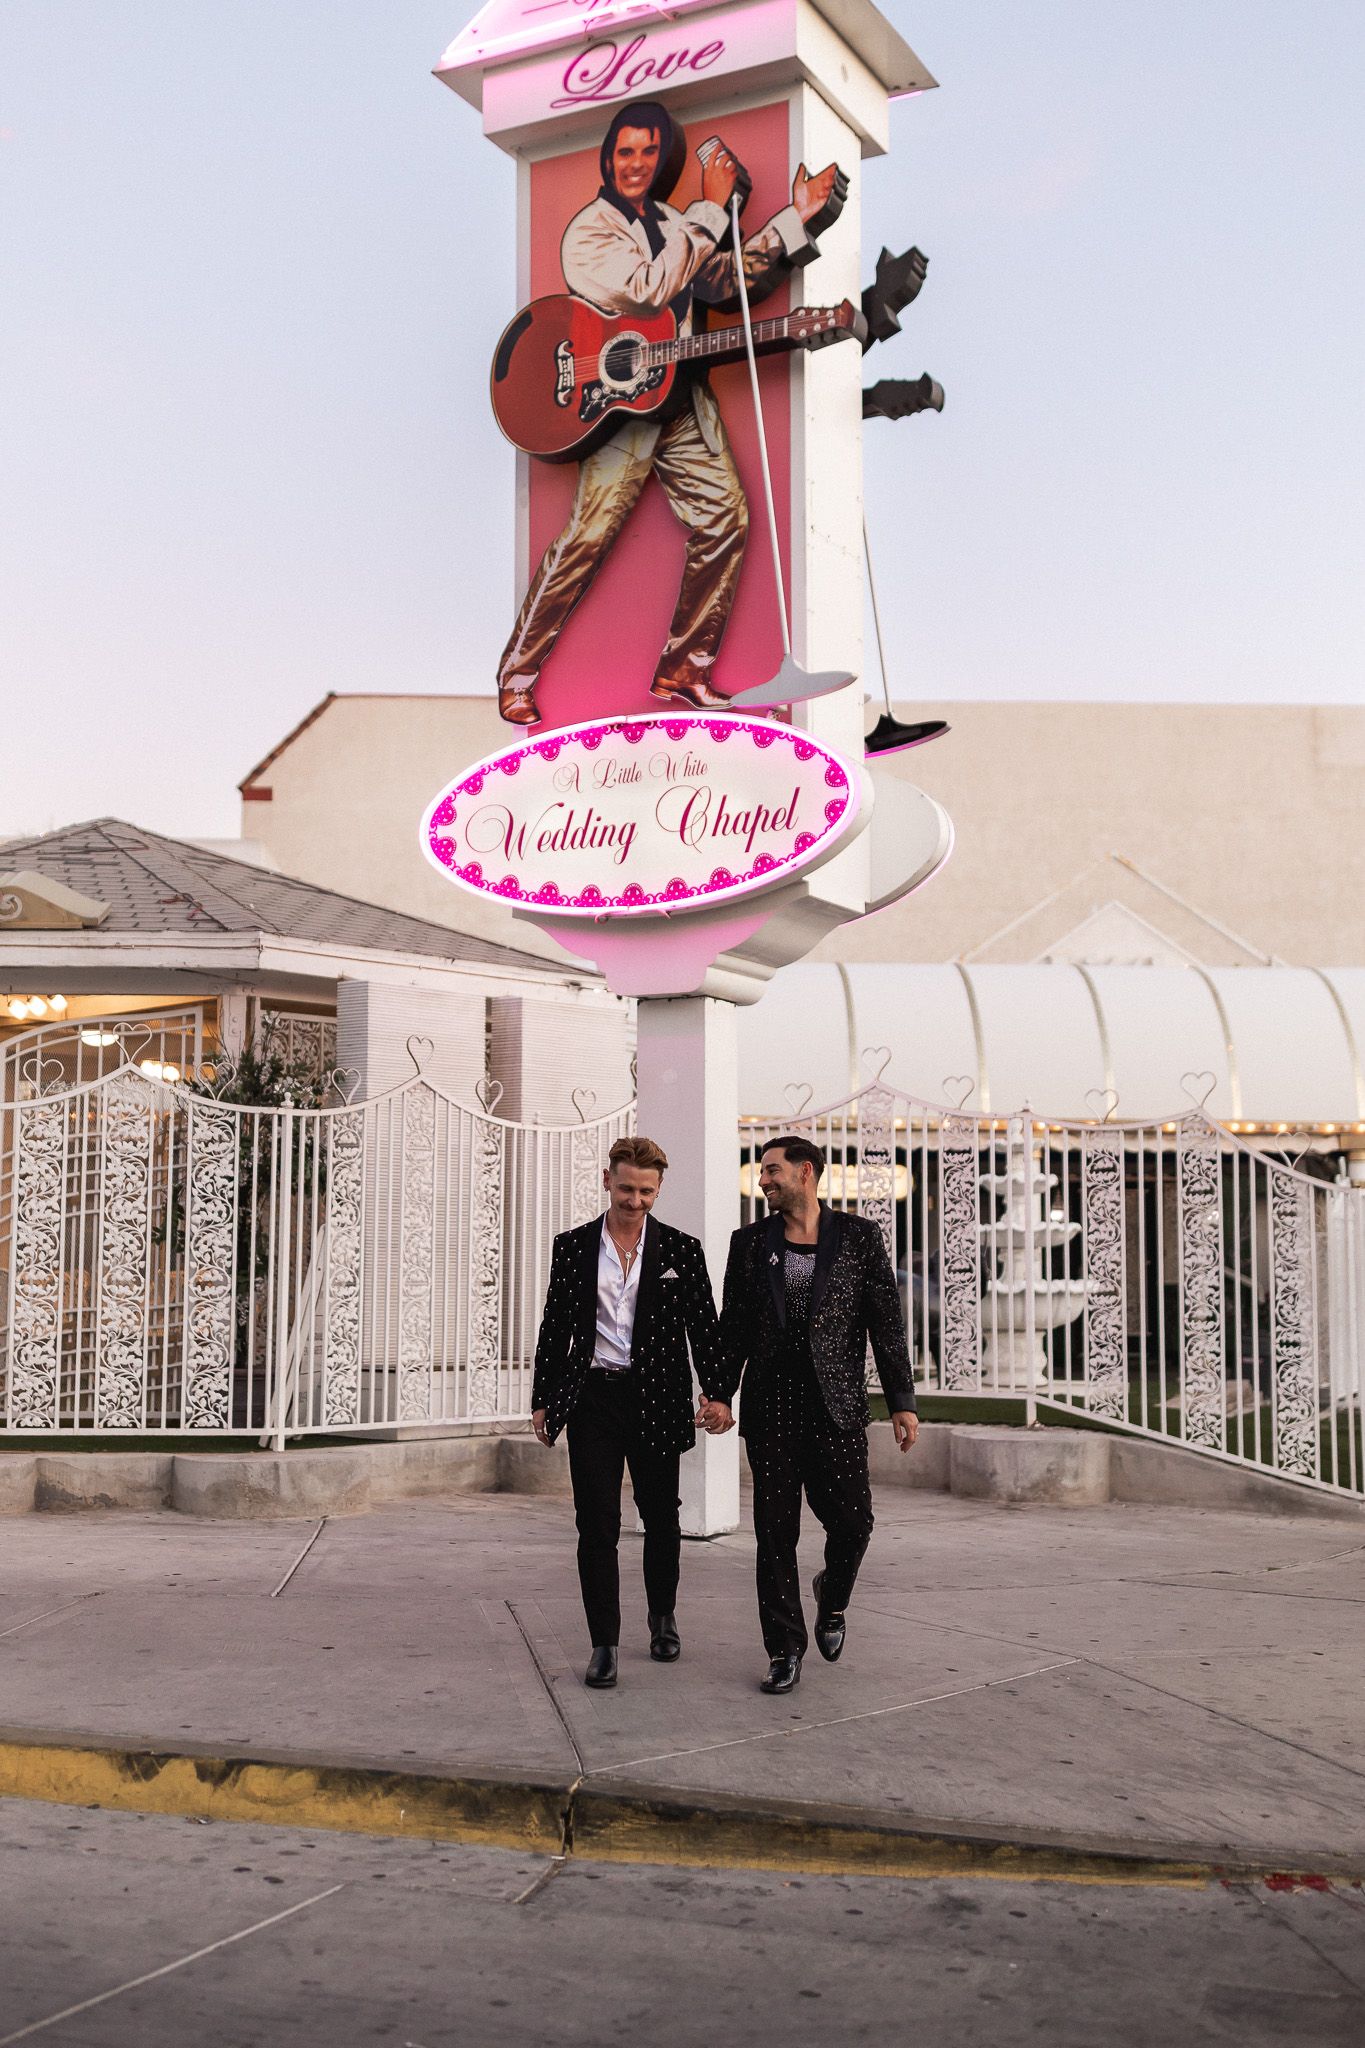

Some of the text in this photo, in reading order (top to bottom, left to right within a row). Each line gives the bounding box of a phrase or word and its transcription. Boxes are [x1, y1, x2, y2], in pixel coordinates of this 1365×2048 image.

[550, 34, 725, 108] Love
[553, 751, 708, 793] A Little White
[465, 785, 799, 865] Wedding Chapel
